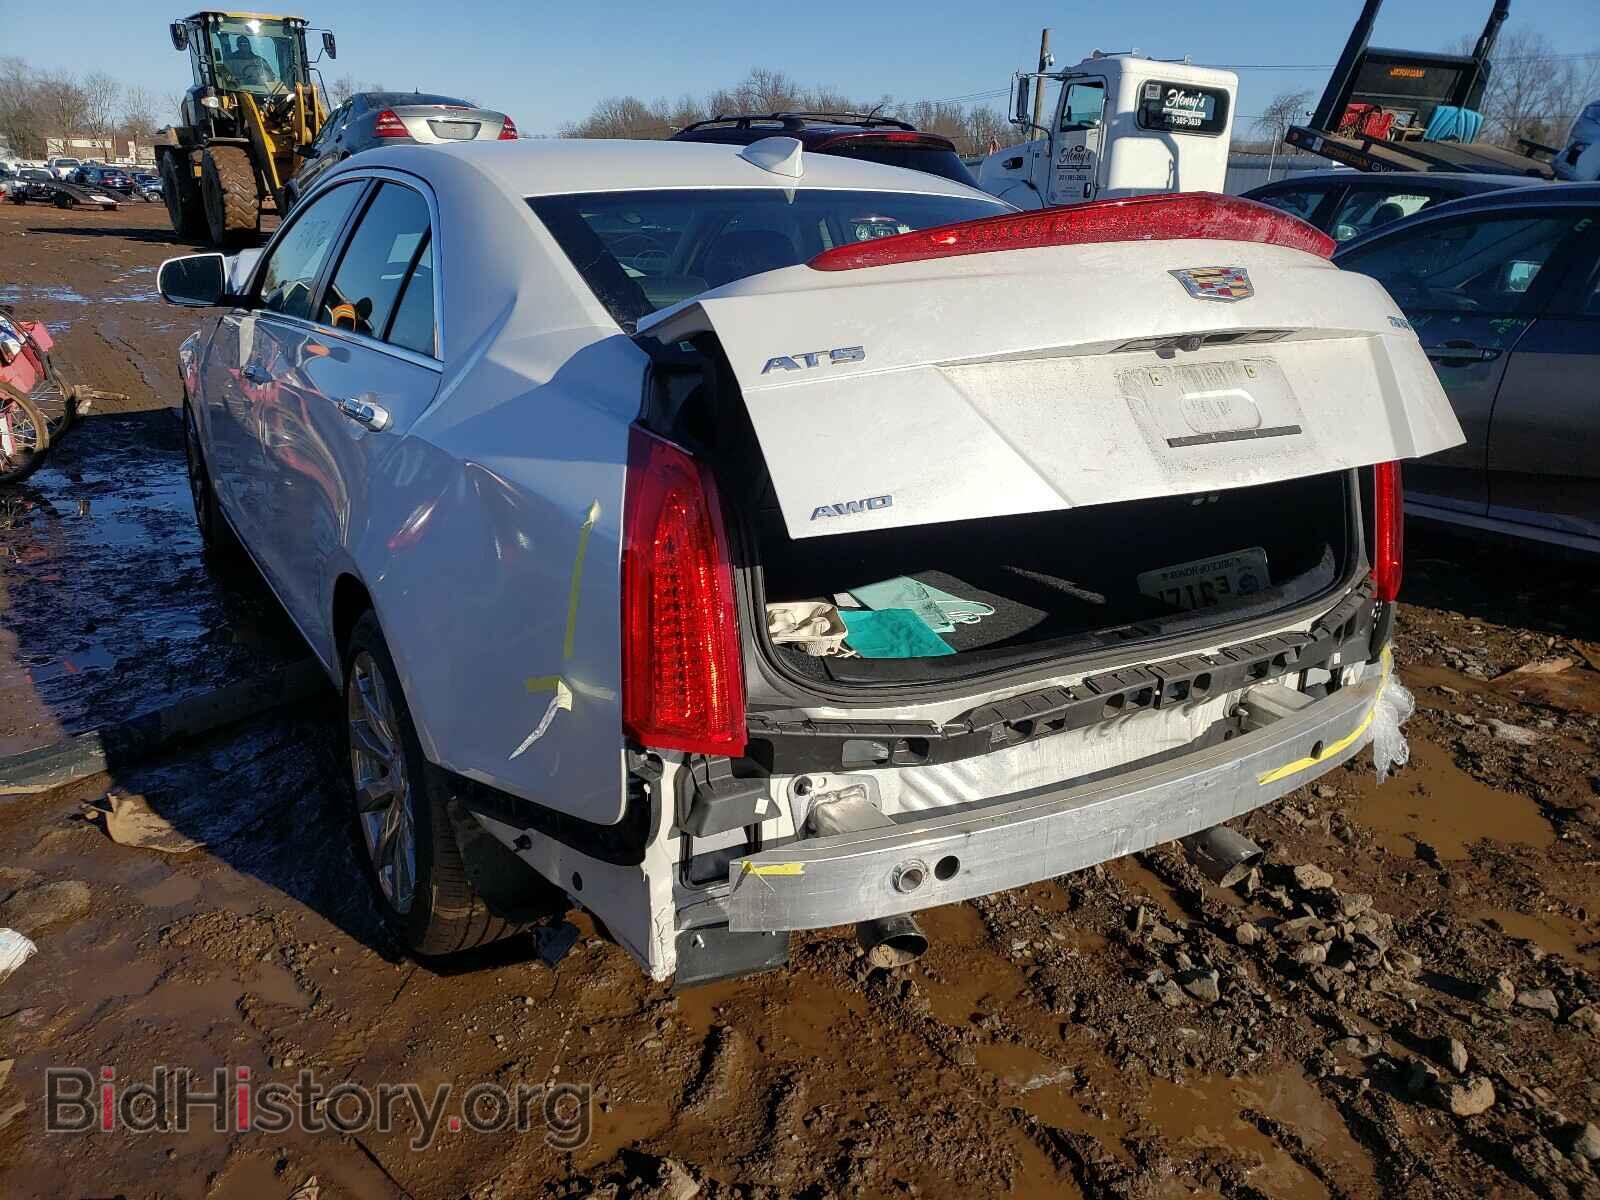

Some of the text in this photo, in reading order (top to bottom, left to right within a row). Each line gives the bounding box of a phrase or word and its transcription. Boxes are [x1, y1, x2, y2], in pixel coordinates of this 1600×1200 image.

[1165, 89, 1206, 112] Henry's
[761, 345, 865, 375] ATS
[809, 494, 892, 521] AWD
